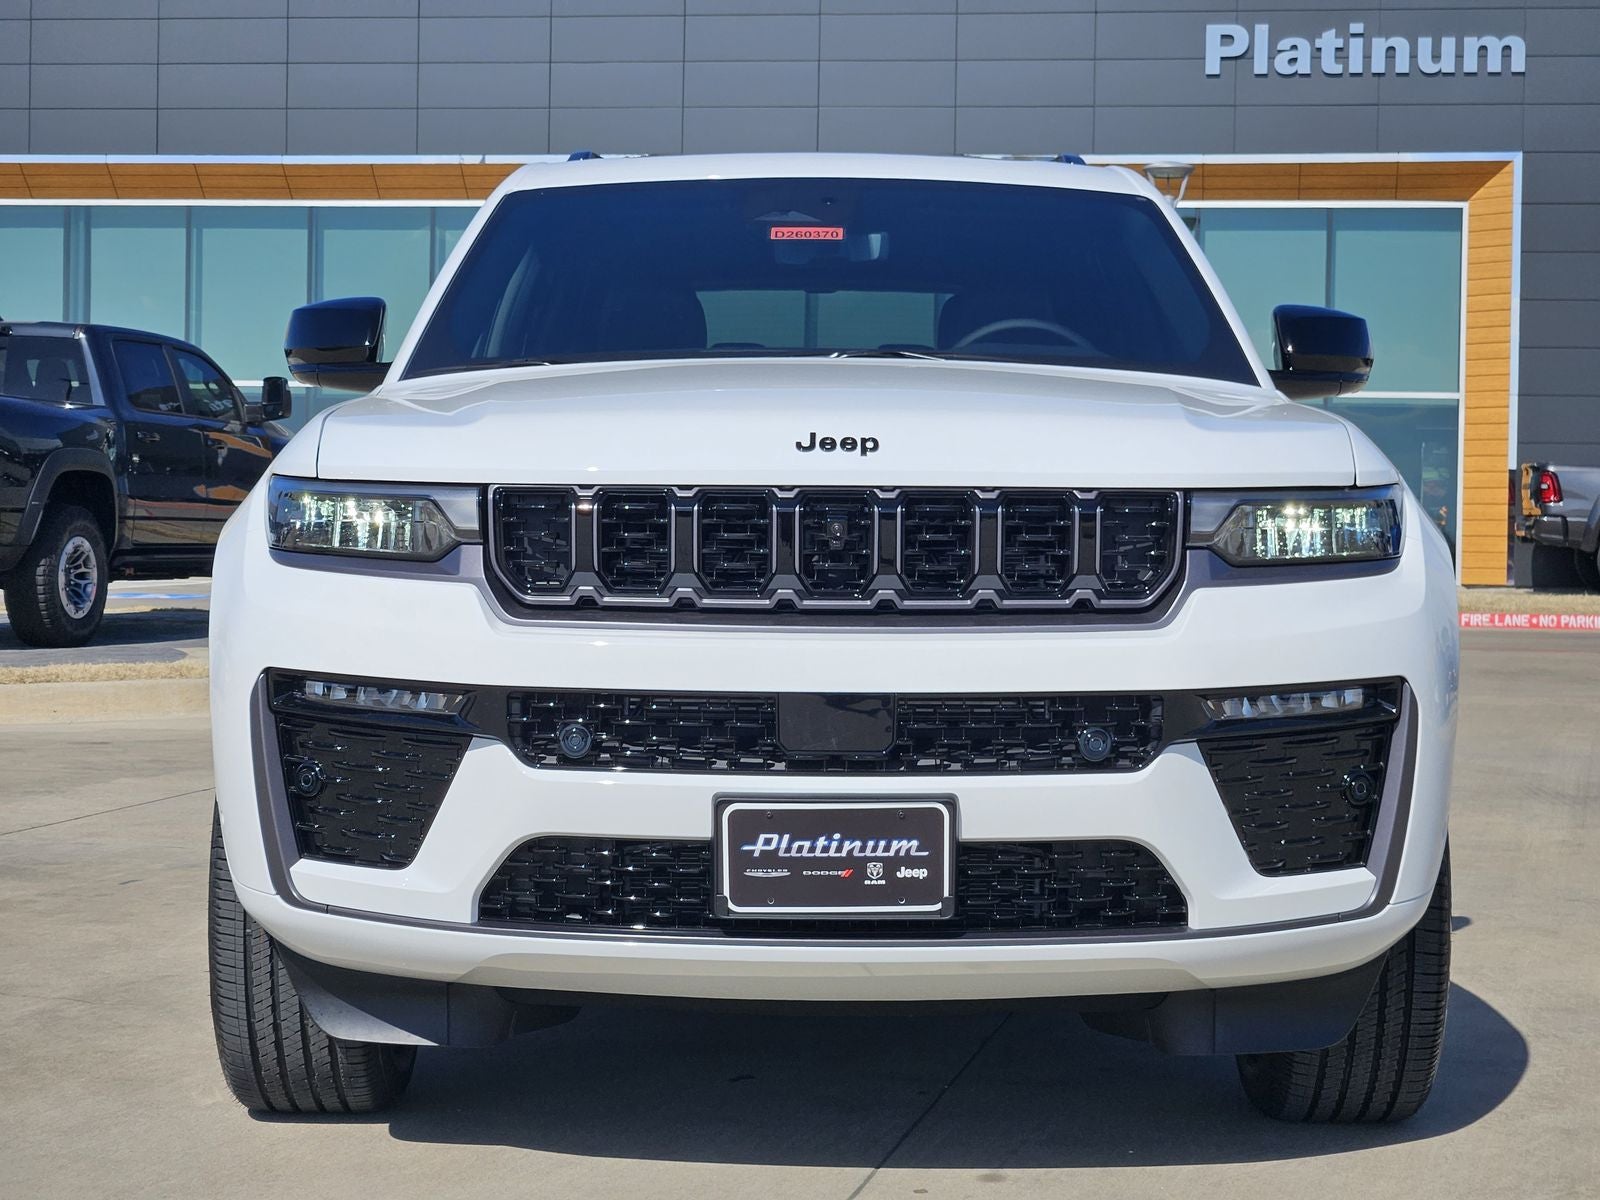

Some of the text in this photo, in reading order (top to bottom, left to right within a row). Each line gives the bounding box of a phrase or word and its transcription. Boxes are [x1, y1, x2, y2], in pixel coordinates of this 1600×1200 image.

[1205, 22, 1527, 76] Platinum
[774, 230, 839, 239] D260370
[795, 432, 880, 457] Jeep
[1461, 613, 1600, 628] FIRE LANE NO PARKI
[740, 832, 930, 858] Platinum
[896, 866, 928, 880] Jeep
